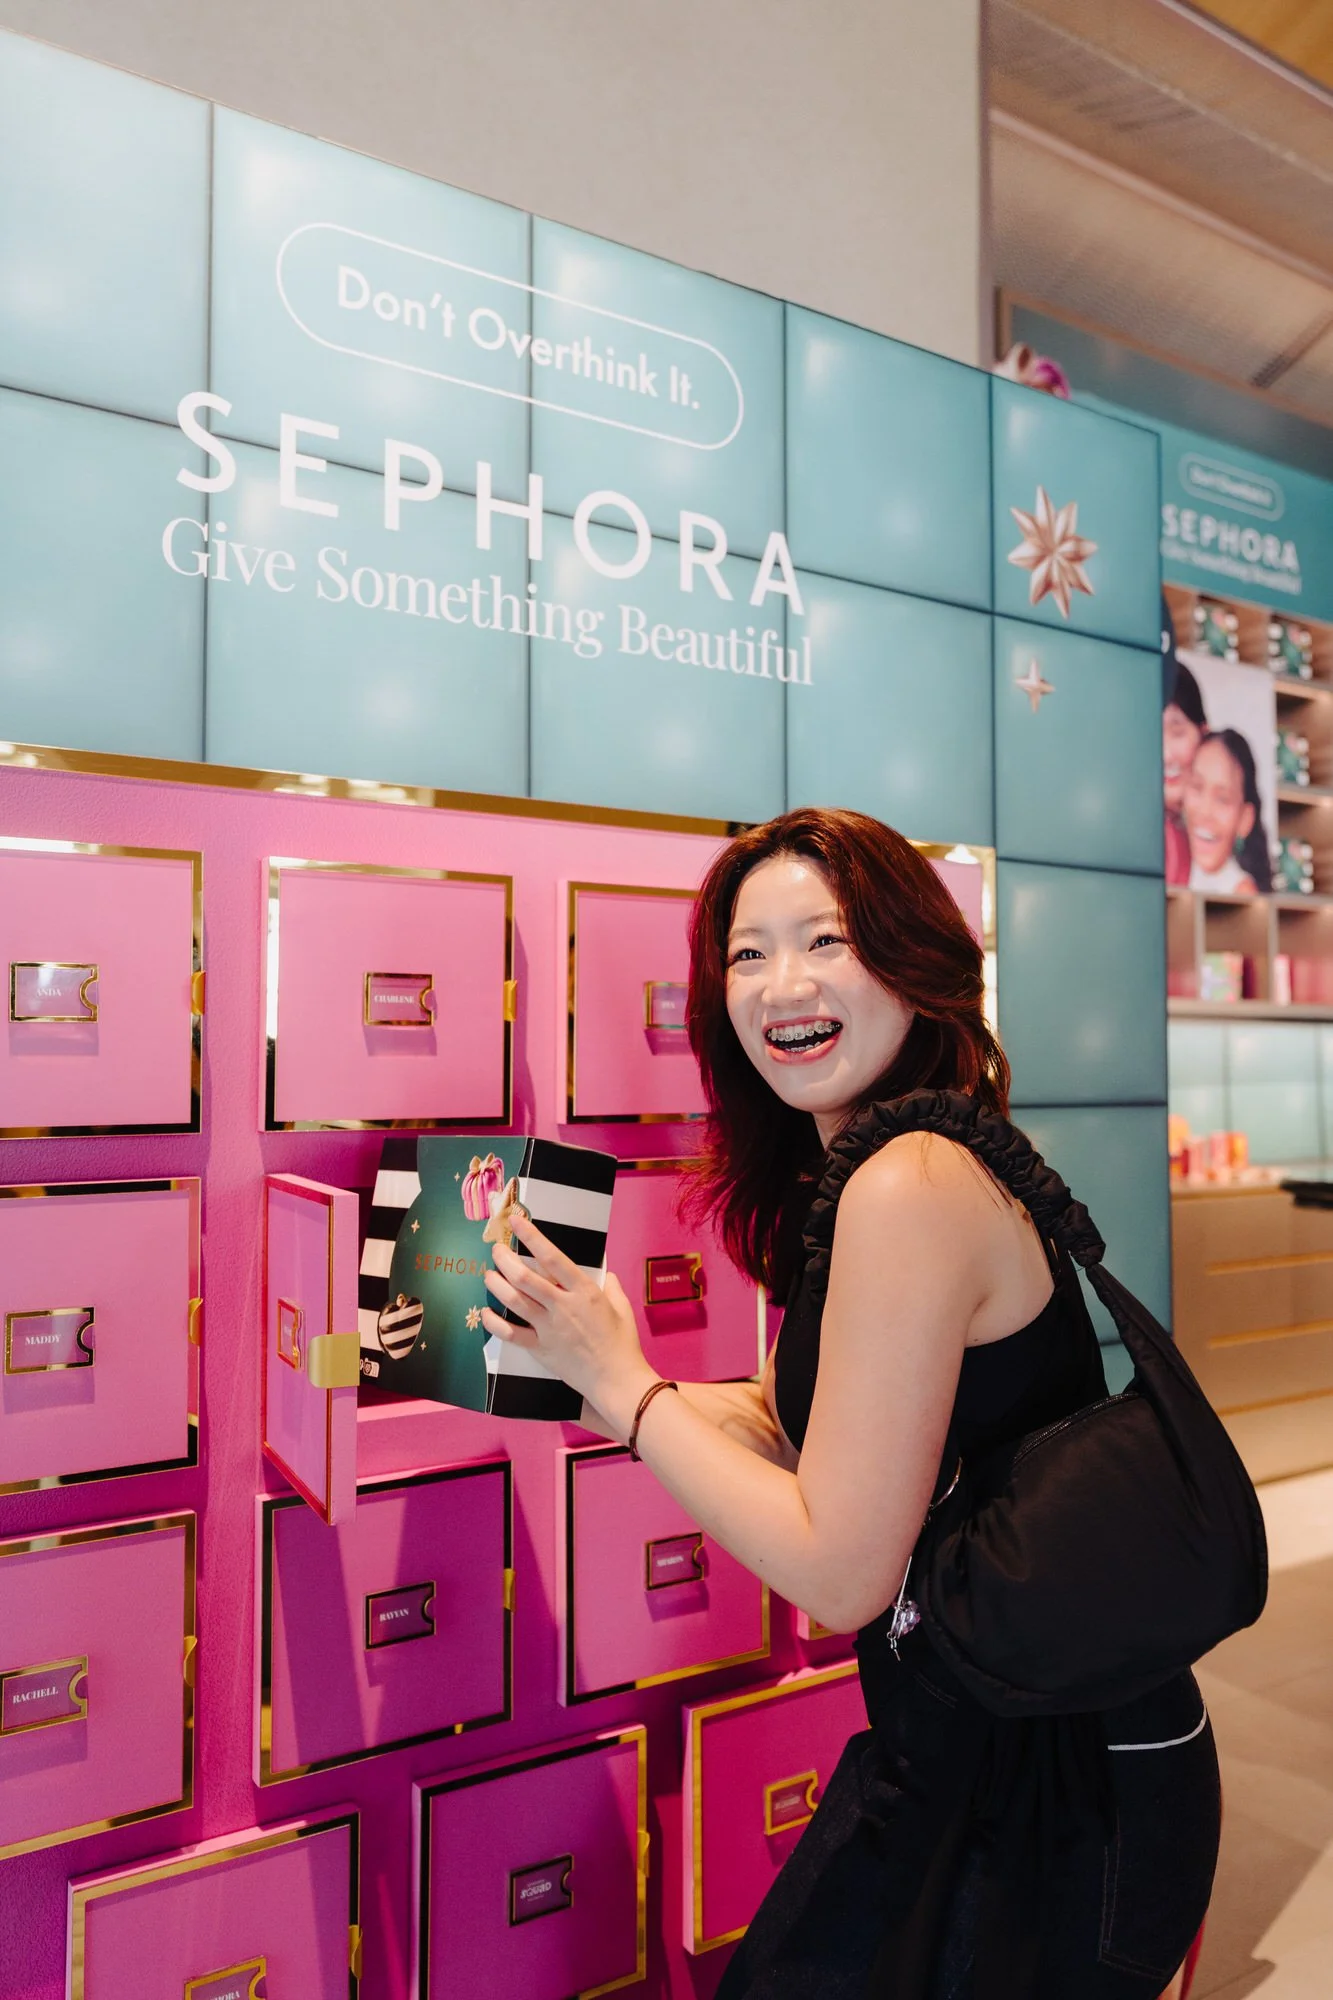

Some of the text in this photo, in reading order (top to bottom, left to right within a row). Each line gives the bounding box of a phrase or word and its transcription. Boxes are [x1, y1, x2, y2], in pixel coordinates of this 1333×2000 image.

[337, 264, 701, 410] Don't Overthink It.
[175, 390, 806, 617] SEPHORA
[1161, 503, 1300, 575] SEPHORA
[161, 516, 815, 686] Give Something Beautiful
[415, 1252, 487, 1278] SEPHORA
[24, 1334, 61, 1346] MADDY
[12, 1686, 59, 1704] RACHELL
